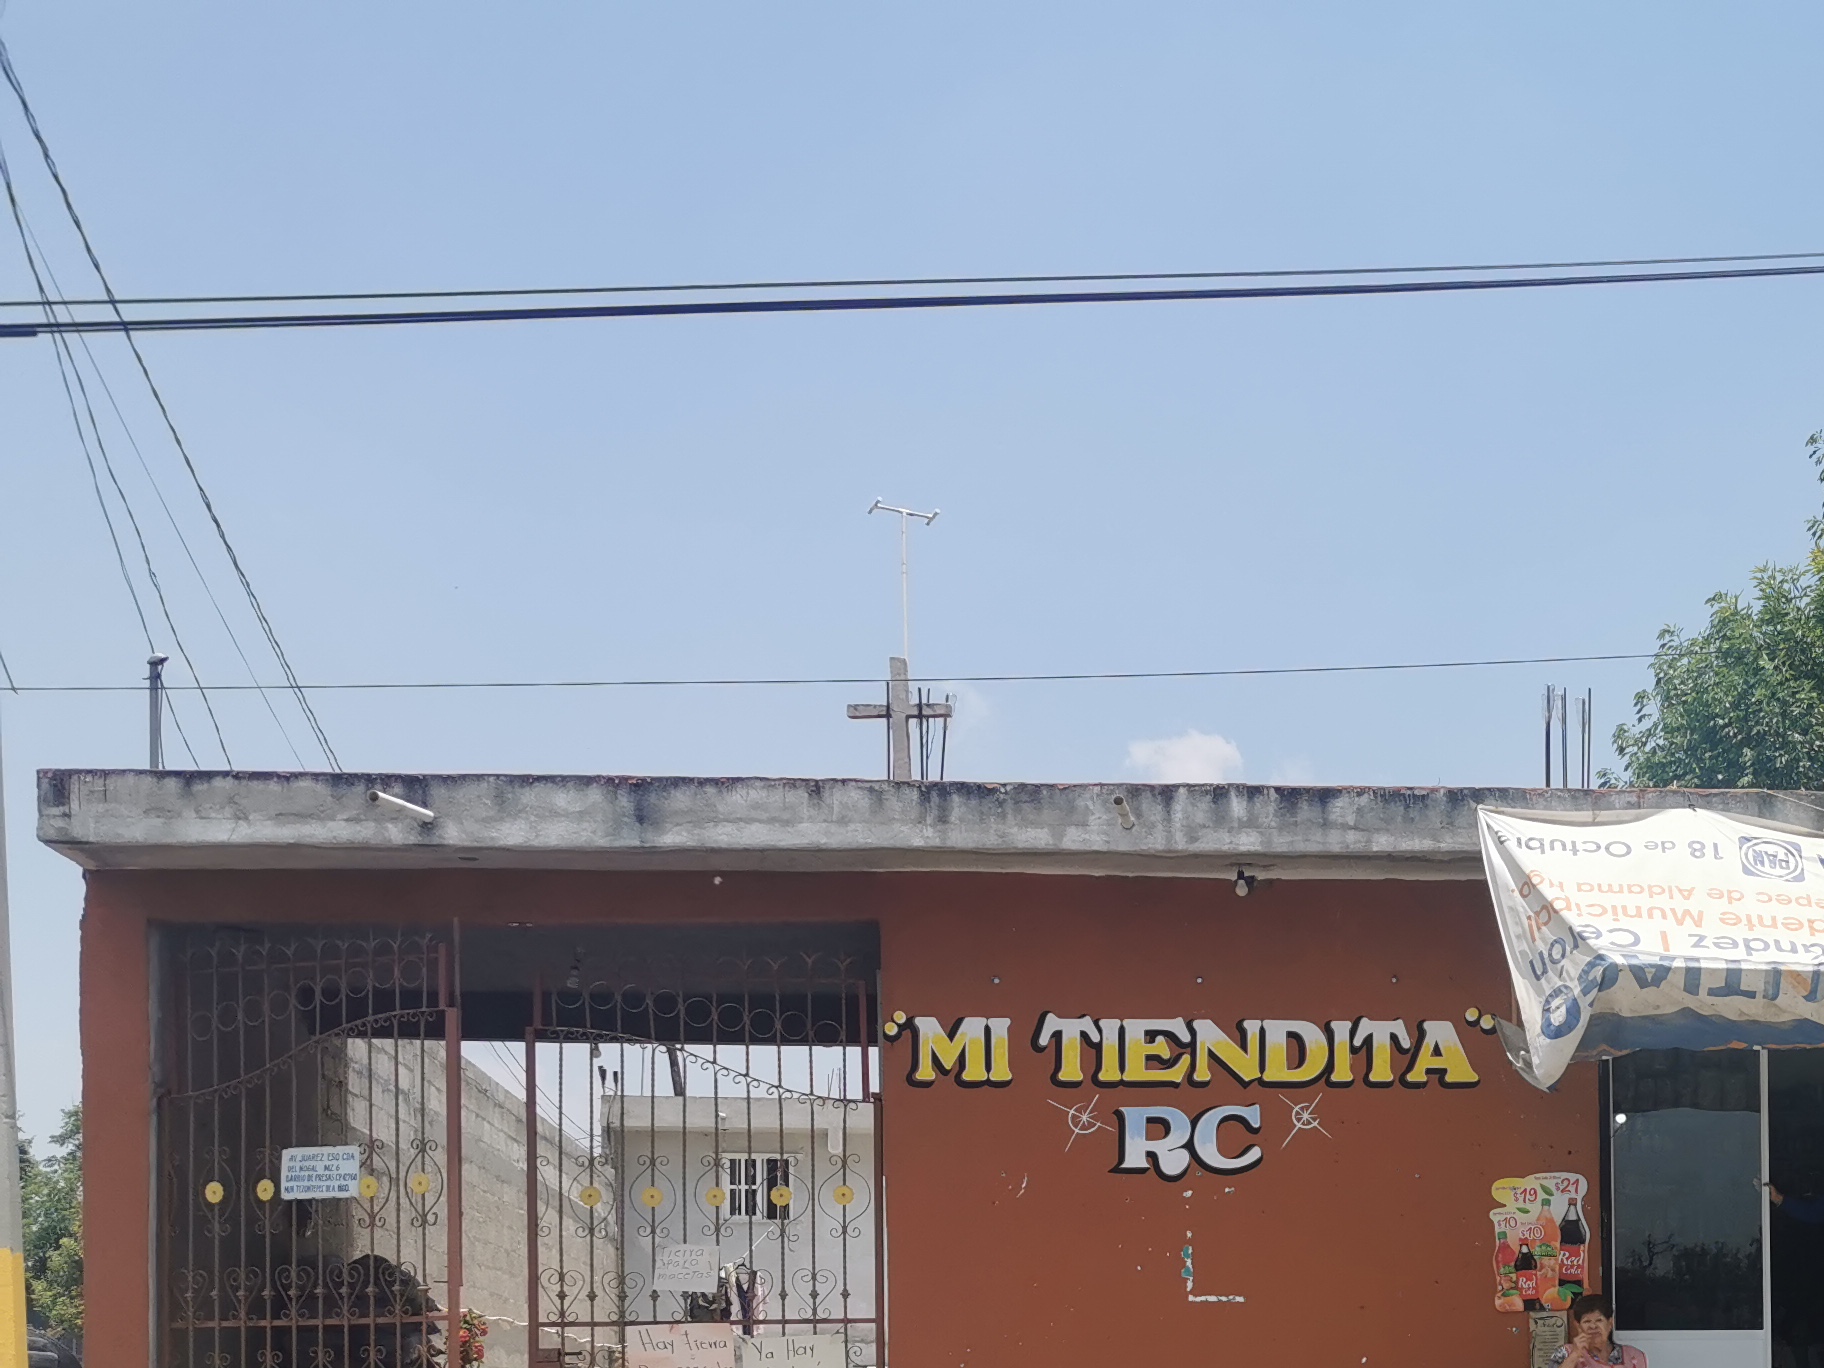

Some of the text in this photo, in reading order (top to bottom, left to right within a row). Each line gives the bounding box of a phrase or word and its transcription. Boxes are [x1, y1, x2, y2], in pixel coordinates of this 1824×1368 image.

[1642, 838, 1676, 854] de
[1688, 841, 1726, 861] 18
[1751, 848, 1792, 872] PAN
[1576, 880, 1696, 901] Aldama
[1706, 887, 1745, 905] de
[1526, 894, 1704, 944] Municipal
[1528, 923, 1641, 982] Cerón
[1107, 1103, 1263, 1179] RC
[1513, 1187, 1538, 1204] $19
[1555, 1178, 1580, 1195] $21
[1497, 1216, 1518, 1229] $10
[1521, 1226, 1543, 1239] $10
[1559, 1249, 1584, 1266] Red
[657, 1270, 712, 1281] macetas
[1518, 1275, 1536, 1288] Red
[638, 1328, 675, 1355] Hay
[750, 1338, 815, 1361] Ya Hay
